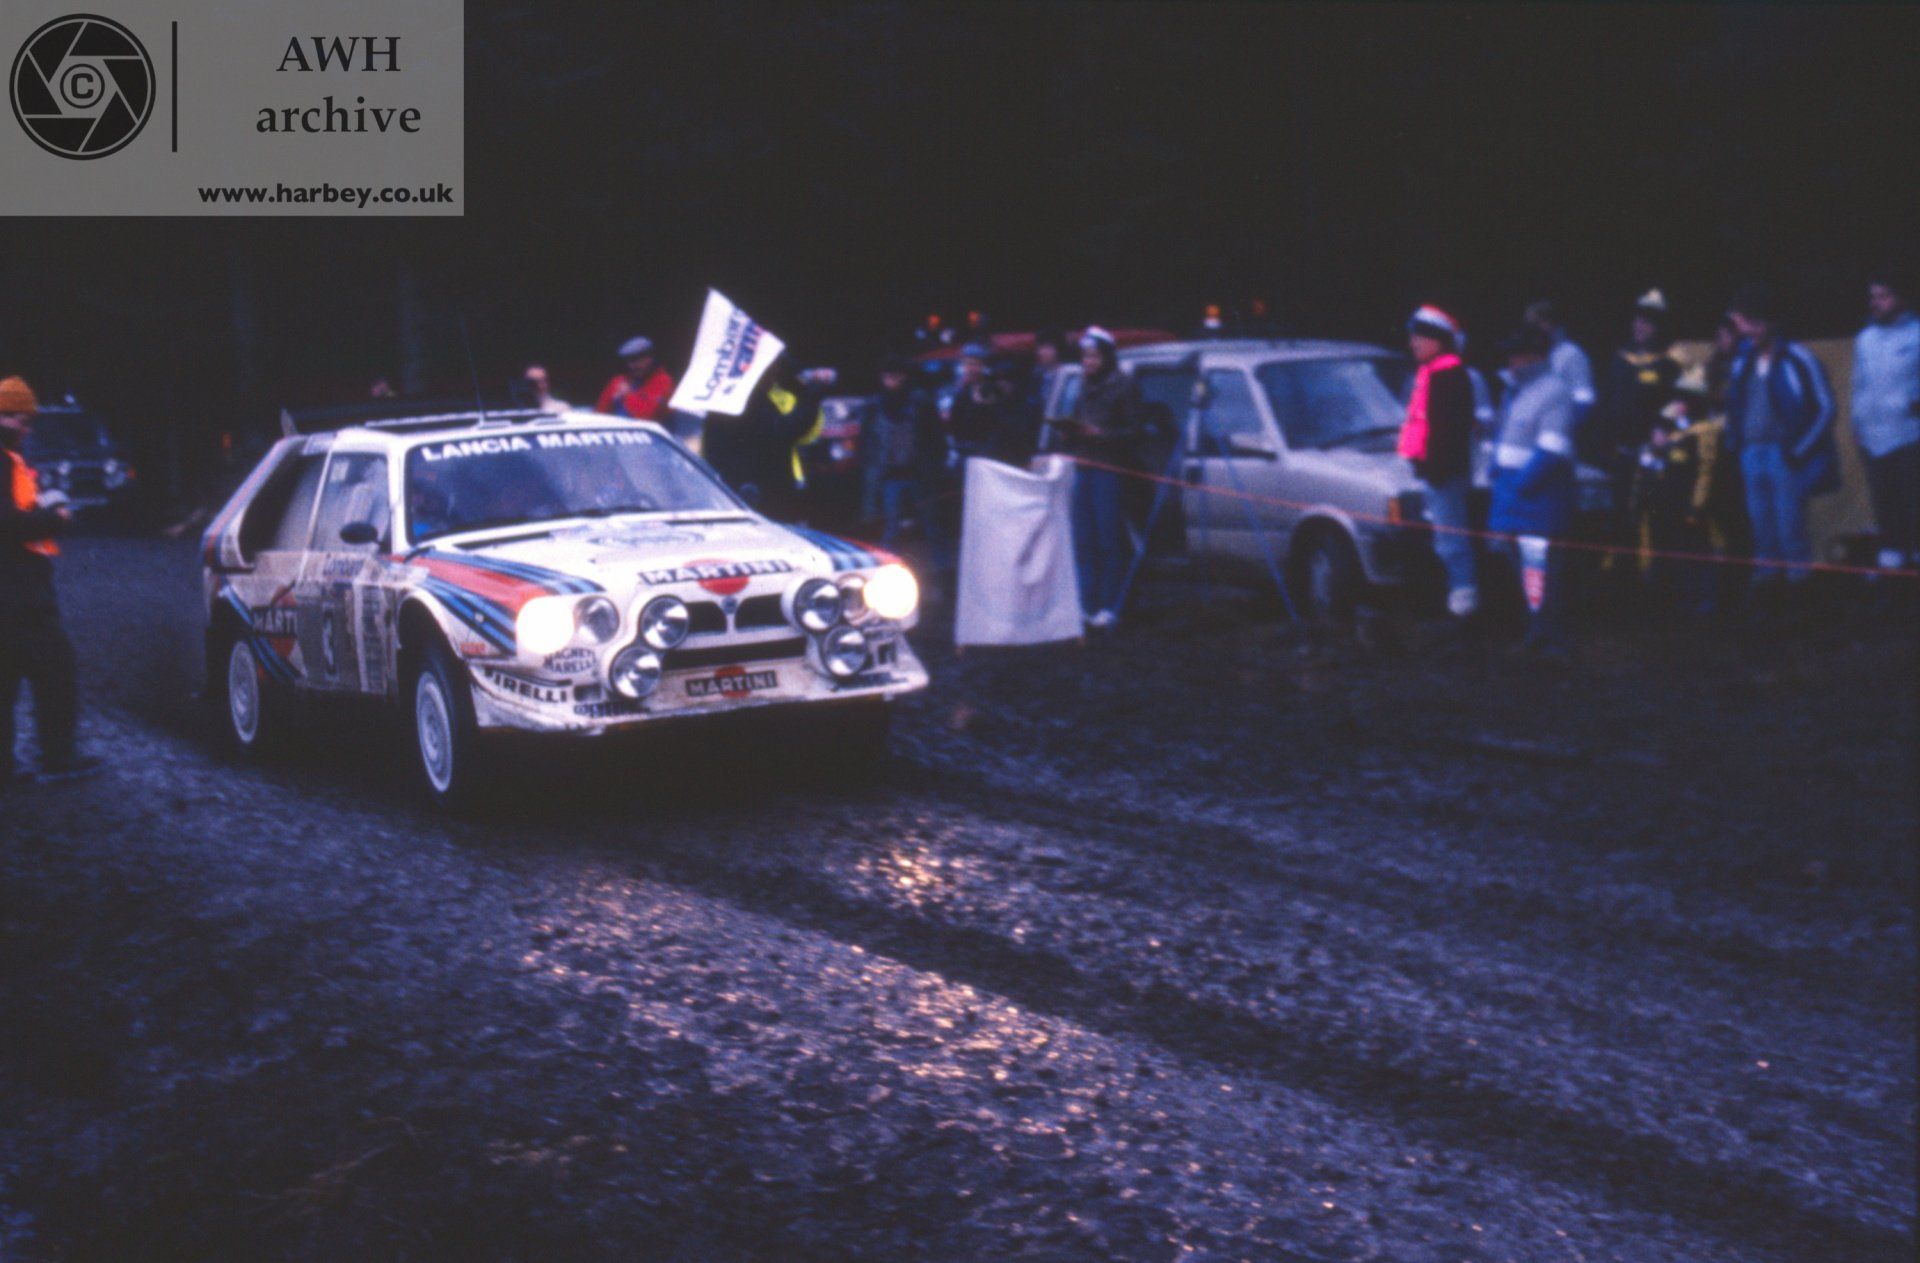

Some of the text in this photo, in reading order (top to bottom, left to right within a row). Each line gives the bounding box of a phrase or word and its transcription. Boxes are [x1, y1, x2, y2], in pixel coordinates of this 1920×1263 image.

[421, 430, 652, 462] LANCIA MARTINI
[637, 559, 793, 585] MARTINI
[484, 666, 568, 703] PIRELLI
[685, 670, 778, 697] MARTINI
